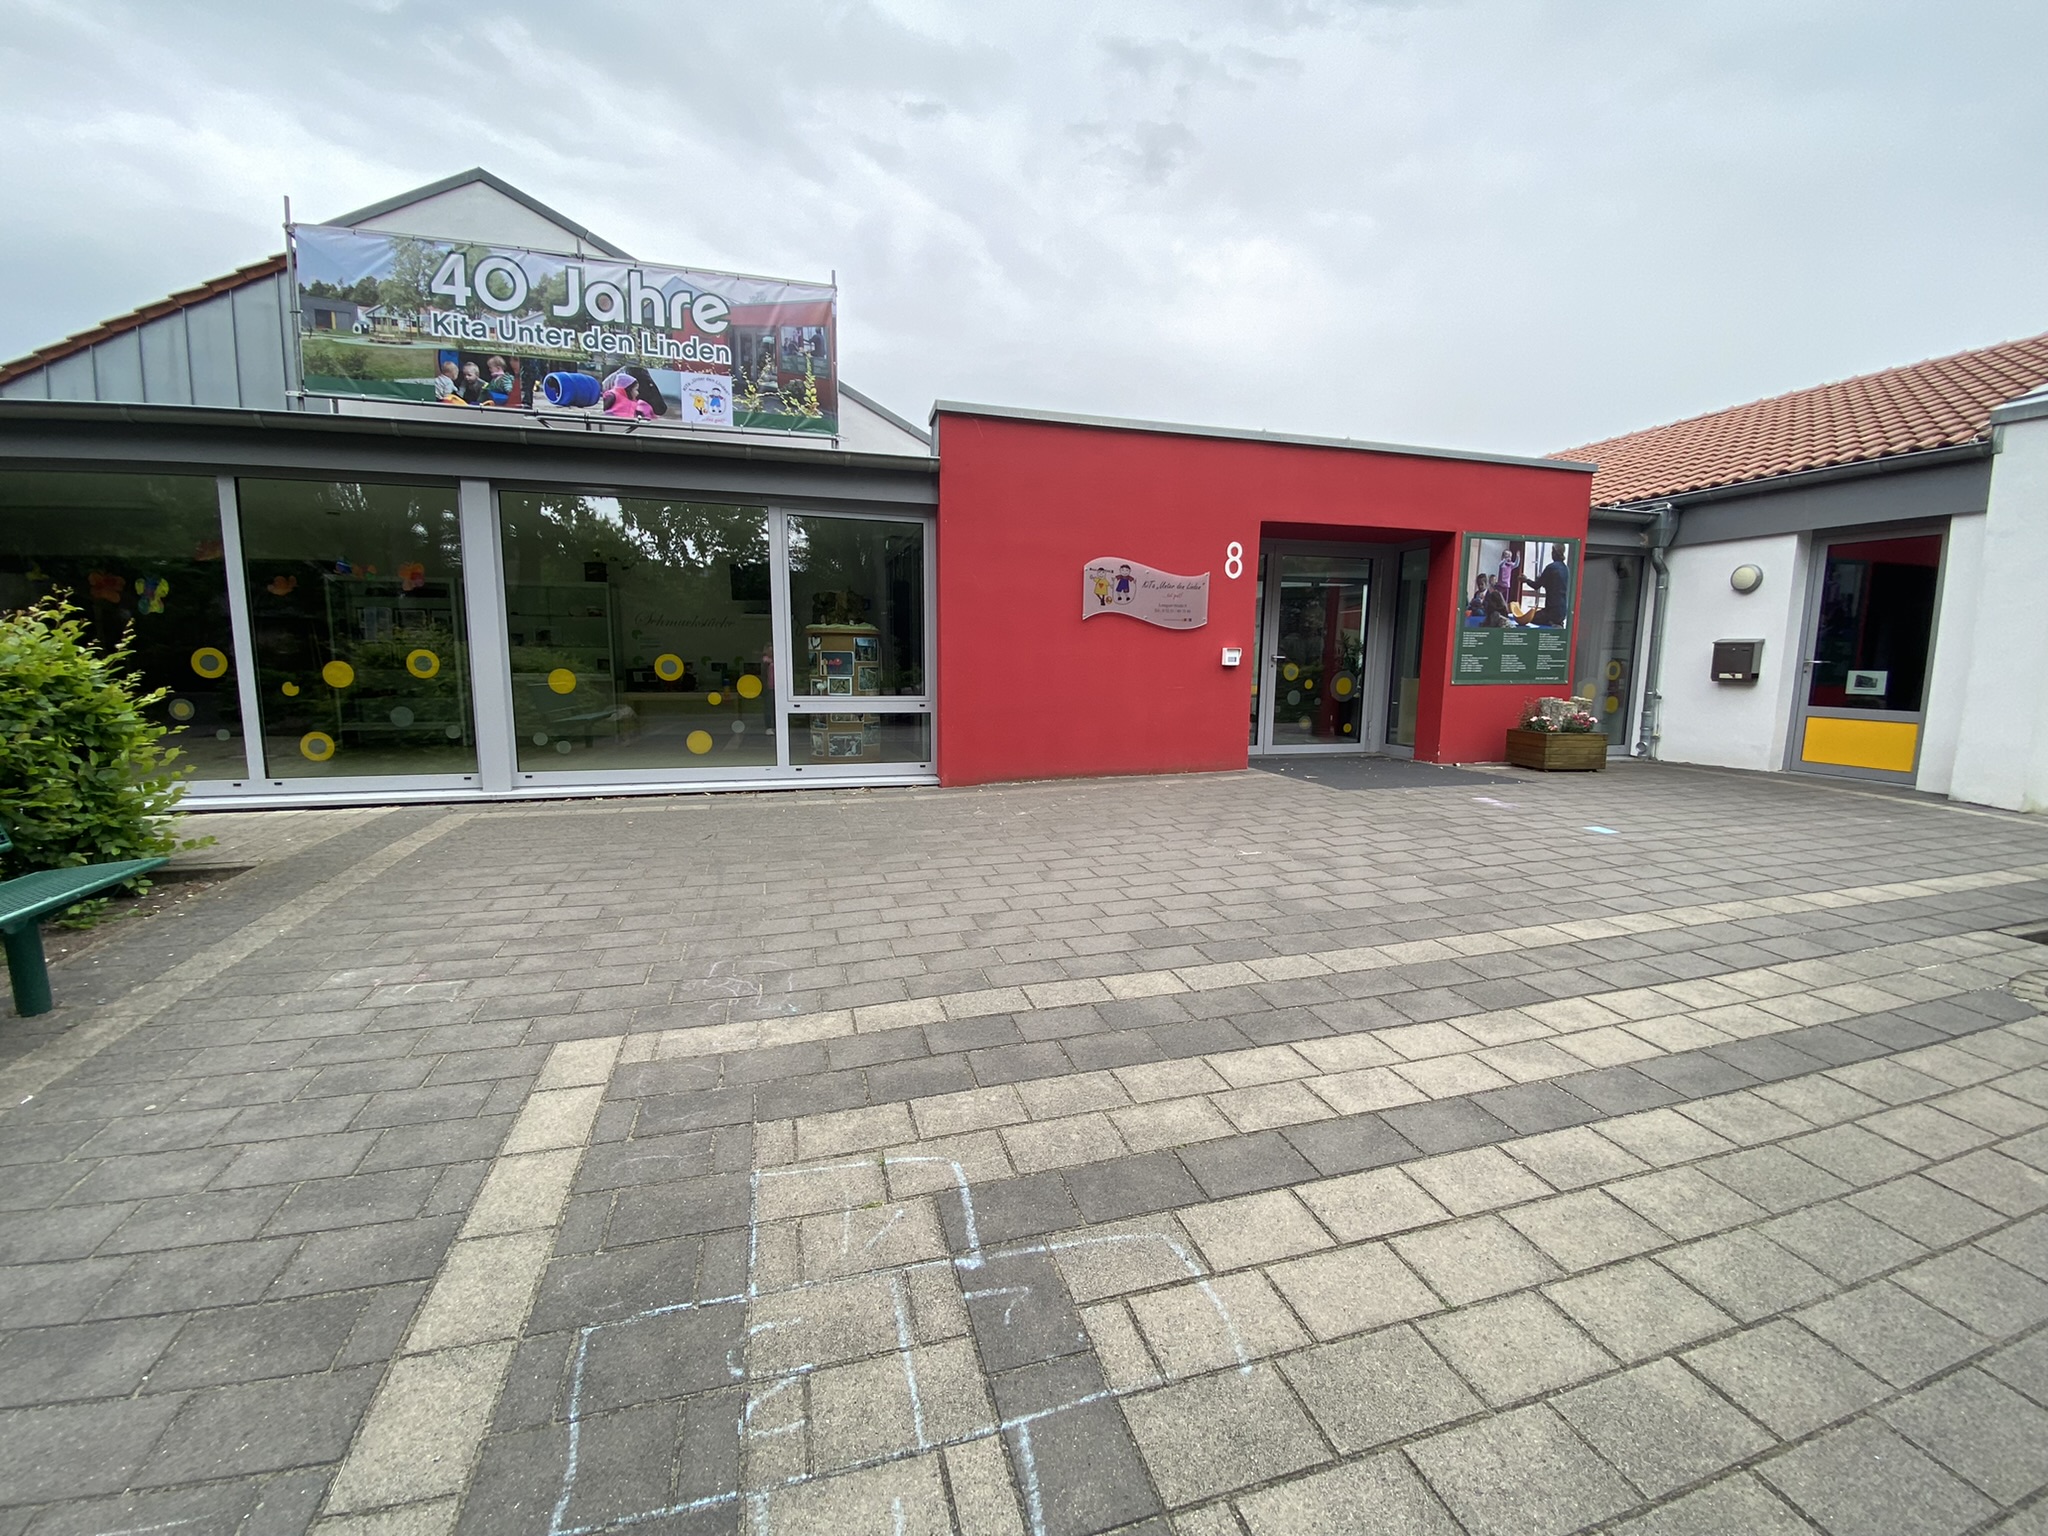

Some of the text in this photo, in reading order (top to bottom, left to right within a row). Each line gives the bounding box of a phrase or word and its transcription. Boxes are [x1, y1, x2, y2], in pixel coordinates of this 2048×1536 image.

[430, 250, 730, 333] 40 Jahre
[431, 311, 733, 365] Kita Unter den Linden
[1224, 541, 1243, 579] 8
